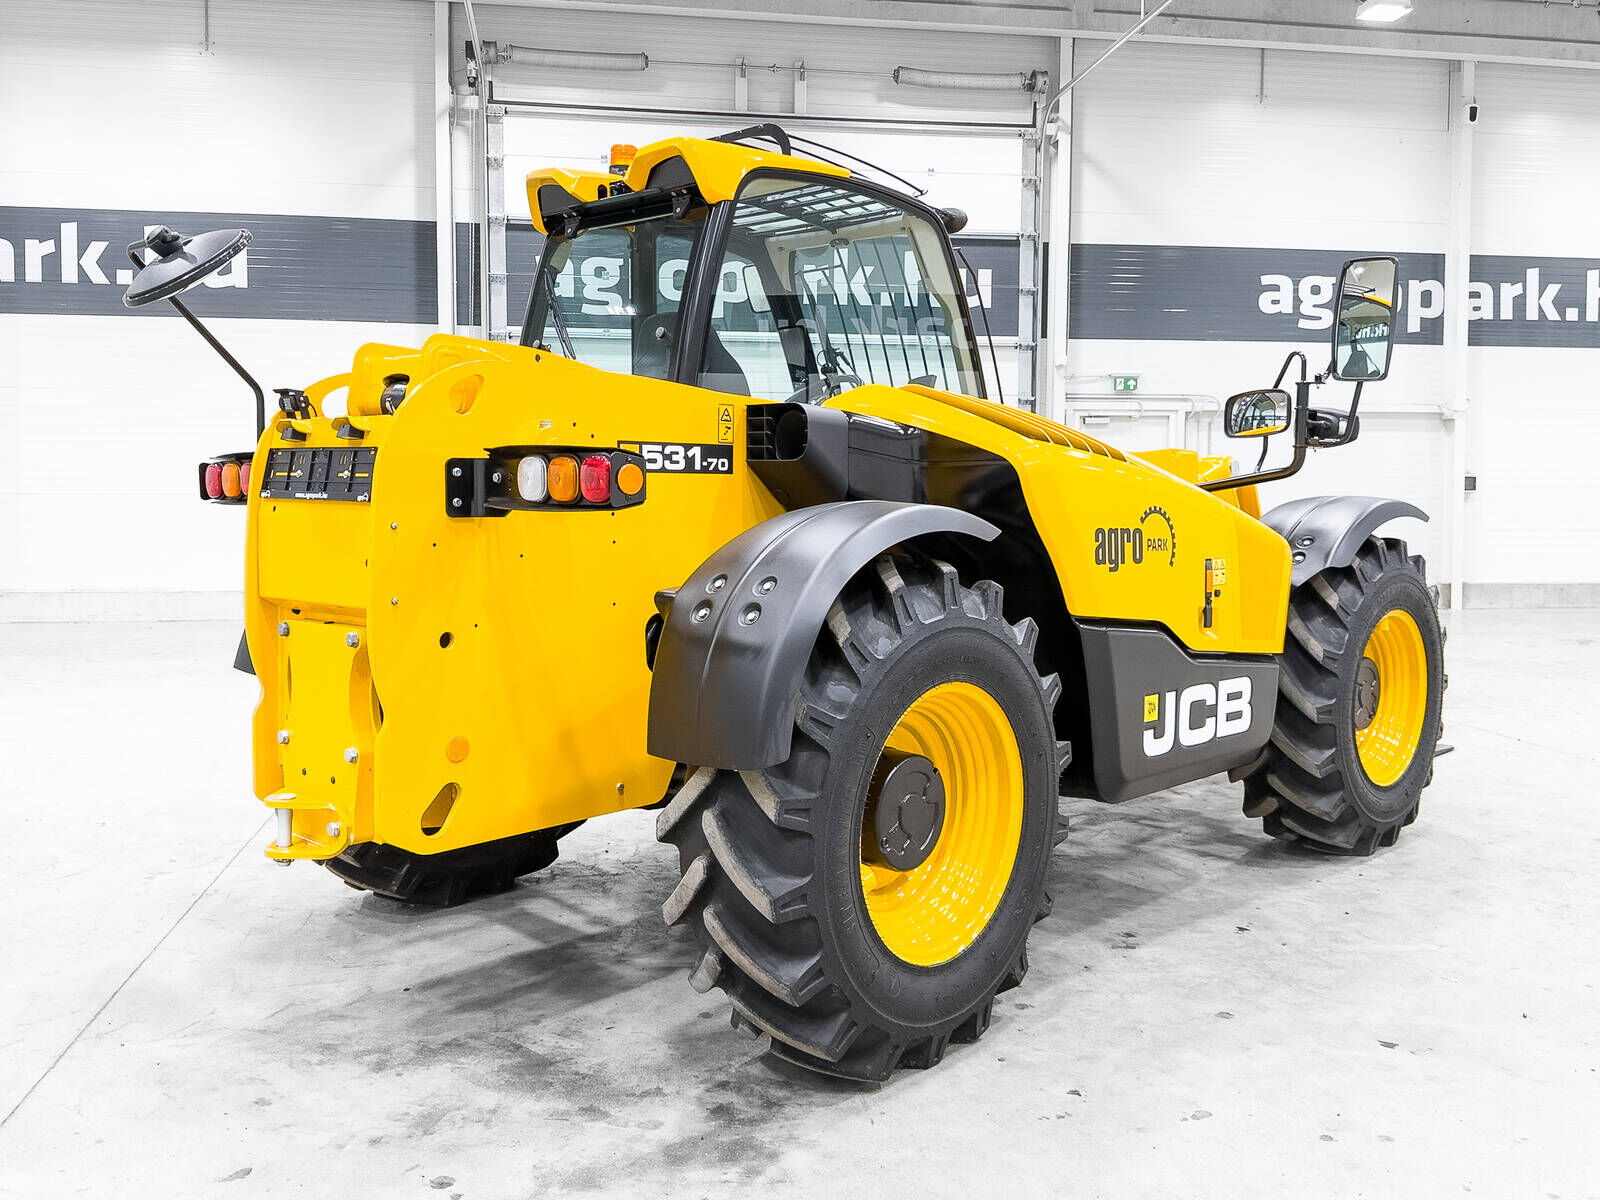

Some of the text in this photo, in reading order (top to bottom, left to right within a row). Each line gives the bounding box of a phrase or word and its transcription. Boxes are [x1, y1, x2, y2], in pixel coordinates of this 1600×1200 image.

[0, 221, 248, 289] rk.u
[642, 444, 729, 471] 531-70
[1095, 528, 1168, 572] agro PARK
[1142, 676, 1252, 757] JCB
